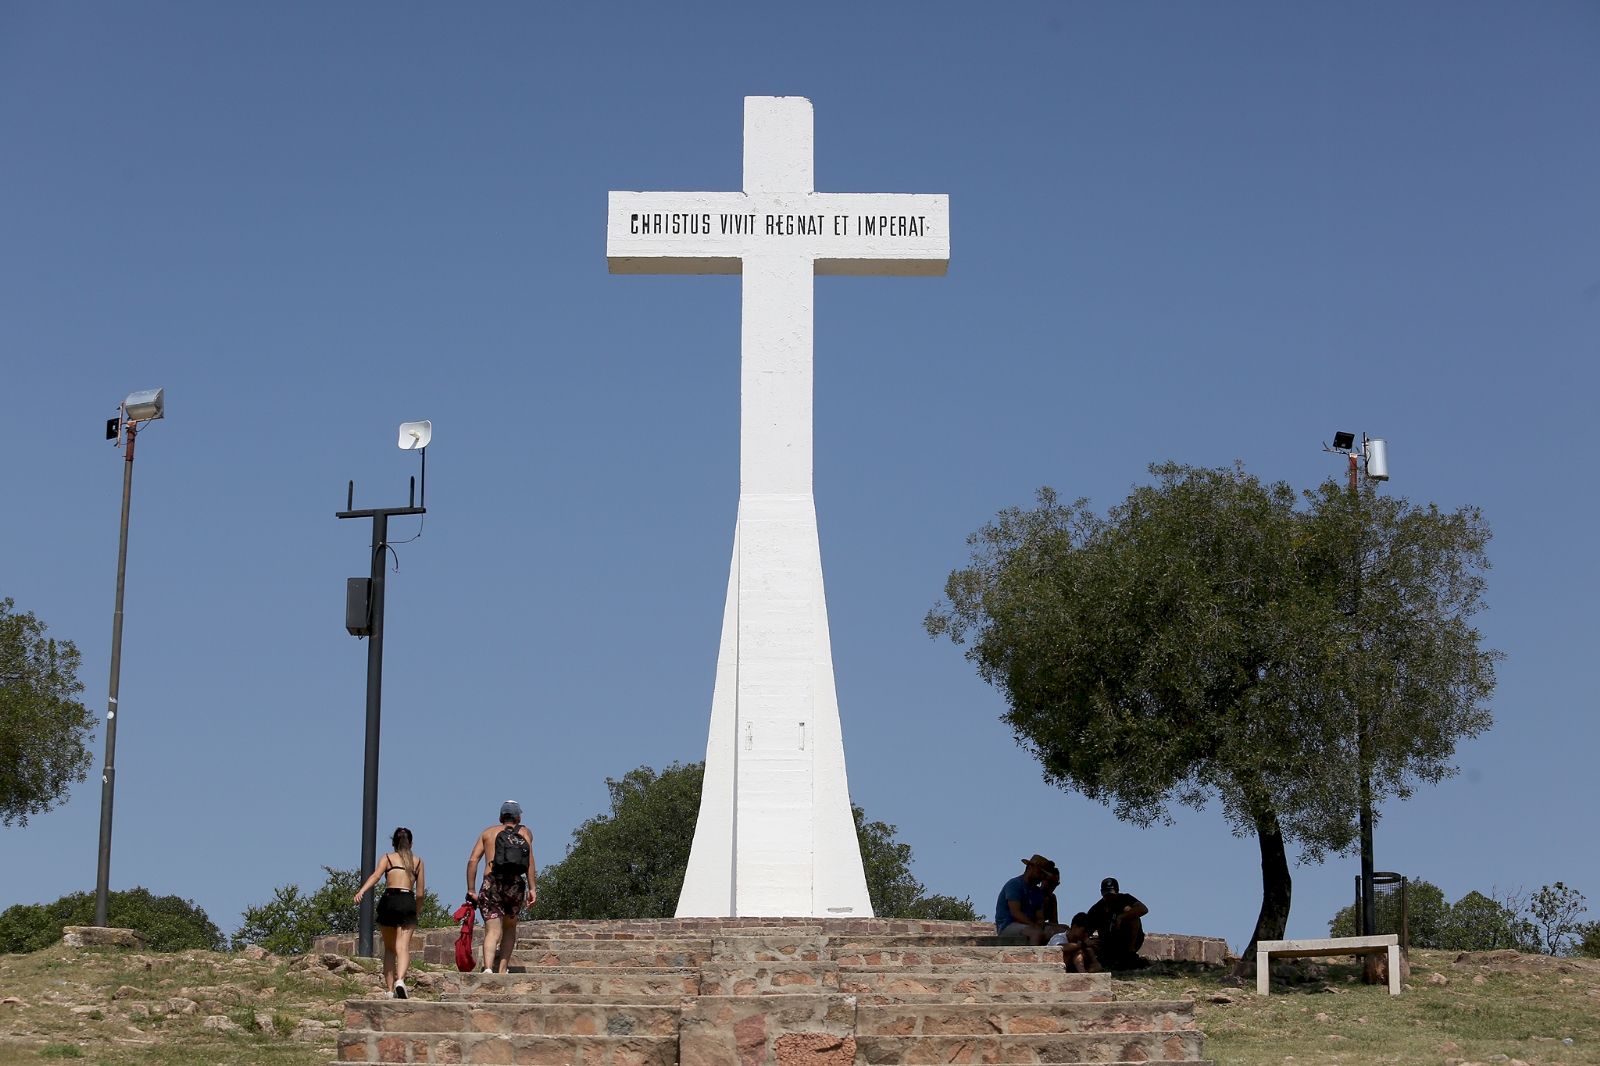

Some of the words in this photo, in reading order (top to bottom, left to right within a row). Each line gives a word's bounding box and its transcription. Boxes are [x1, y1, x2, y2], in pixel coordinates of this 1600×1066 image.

[631, 213, 710, 235] CHRISTUS
[720, 213, 757, 235] VIVIT
[766, 214, 825, 236] REGNAT
[834, 215, 849, 236] ET
[858, 215, 926, 237] IMPERAT
